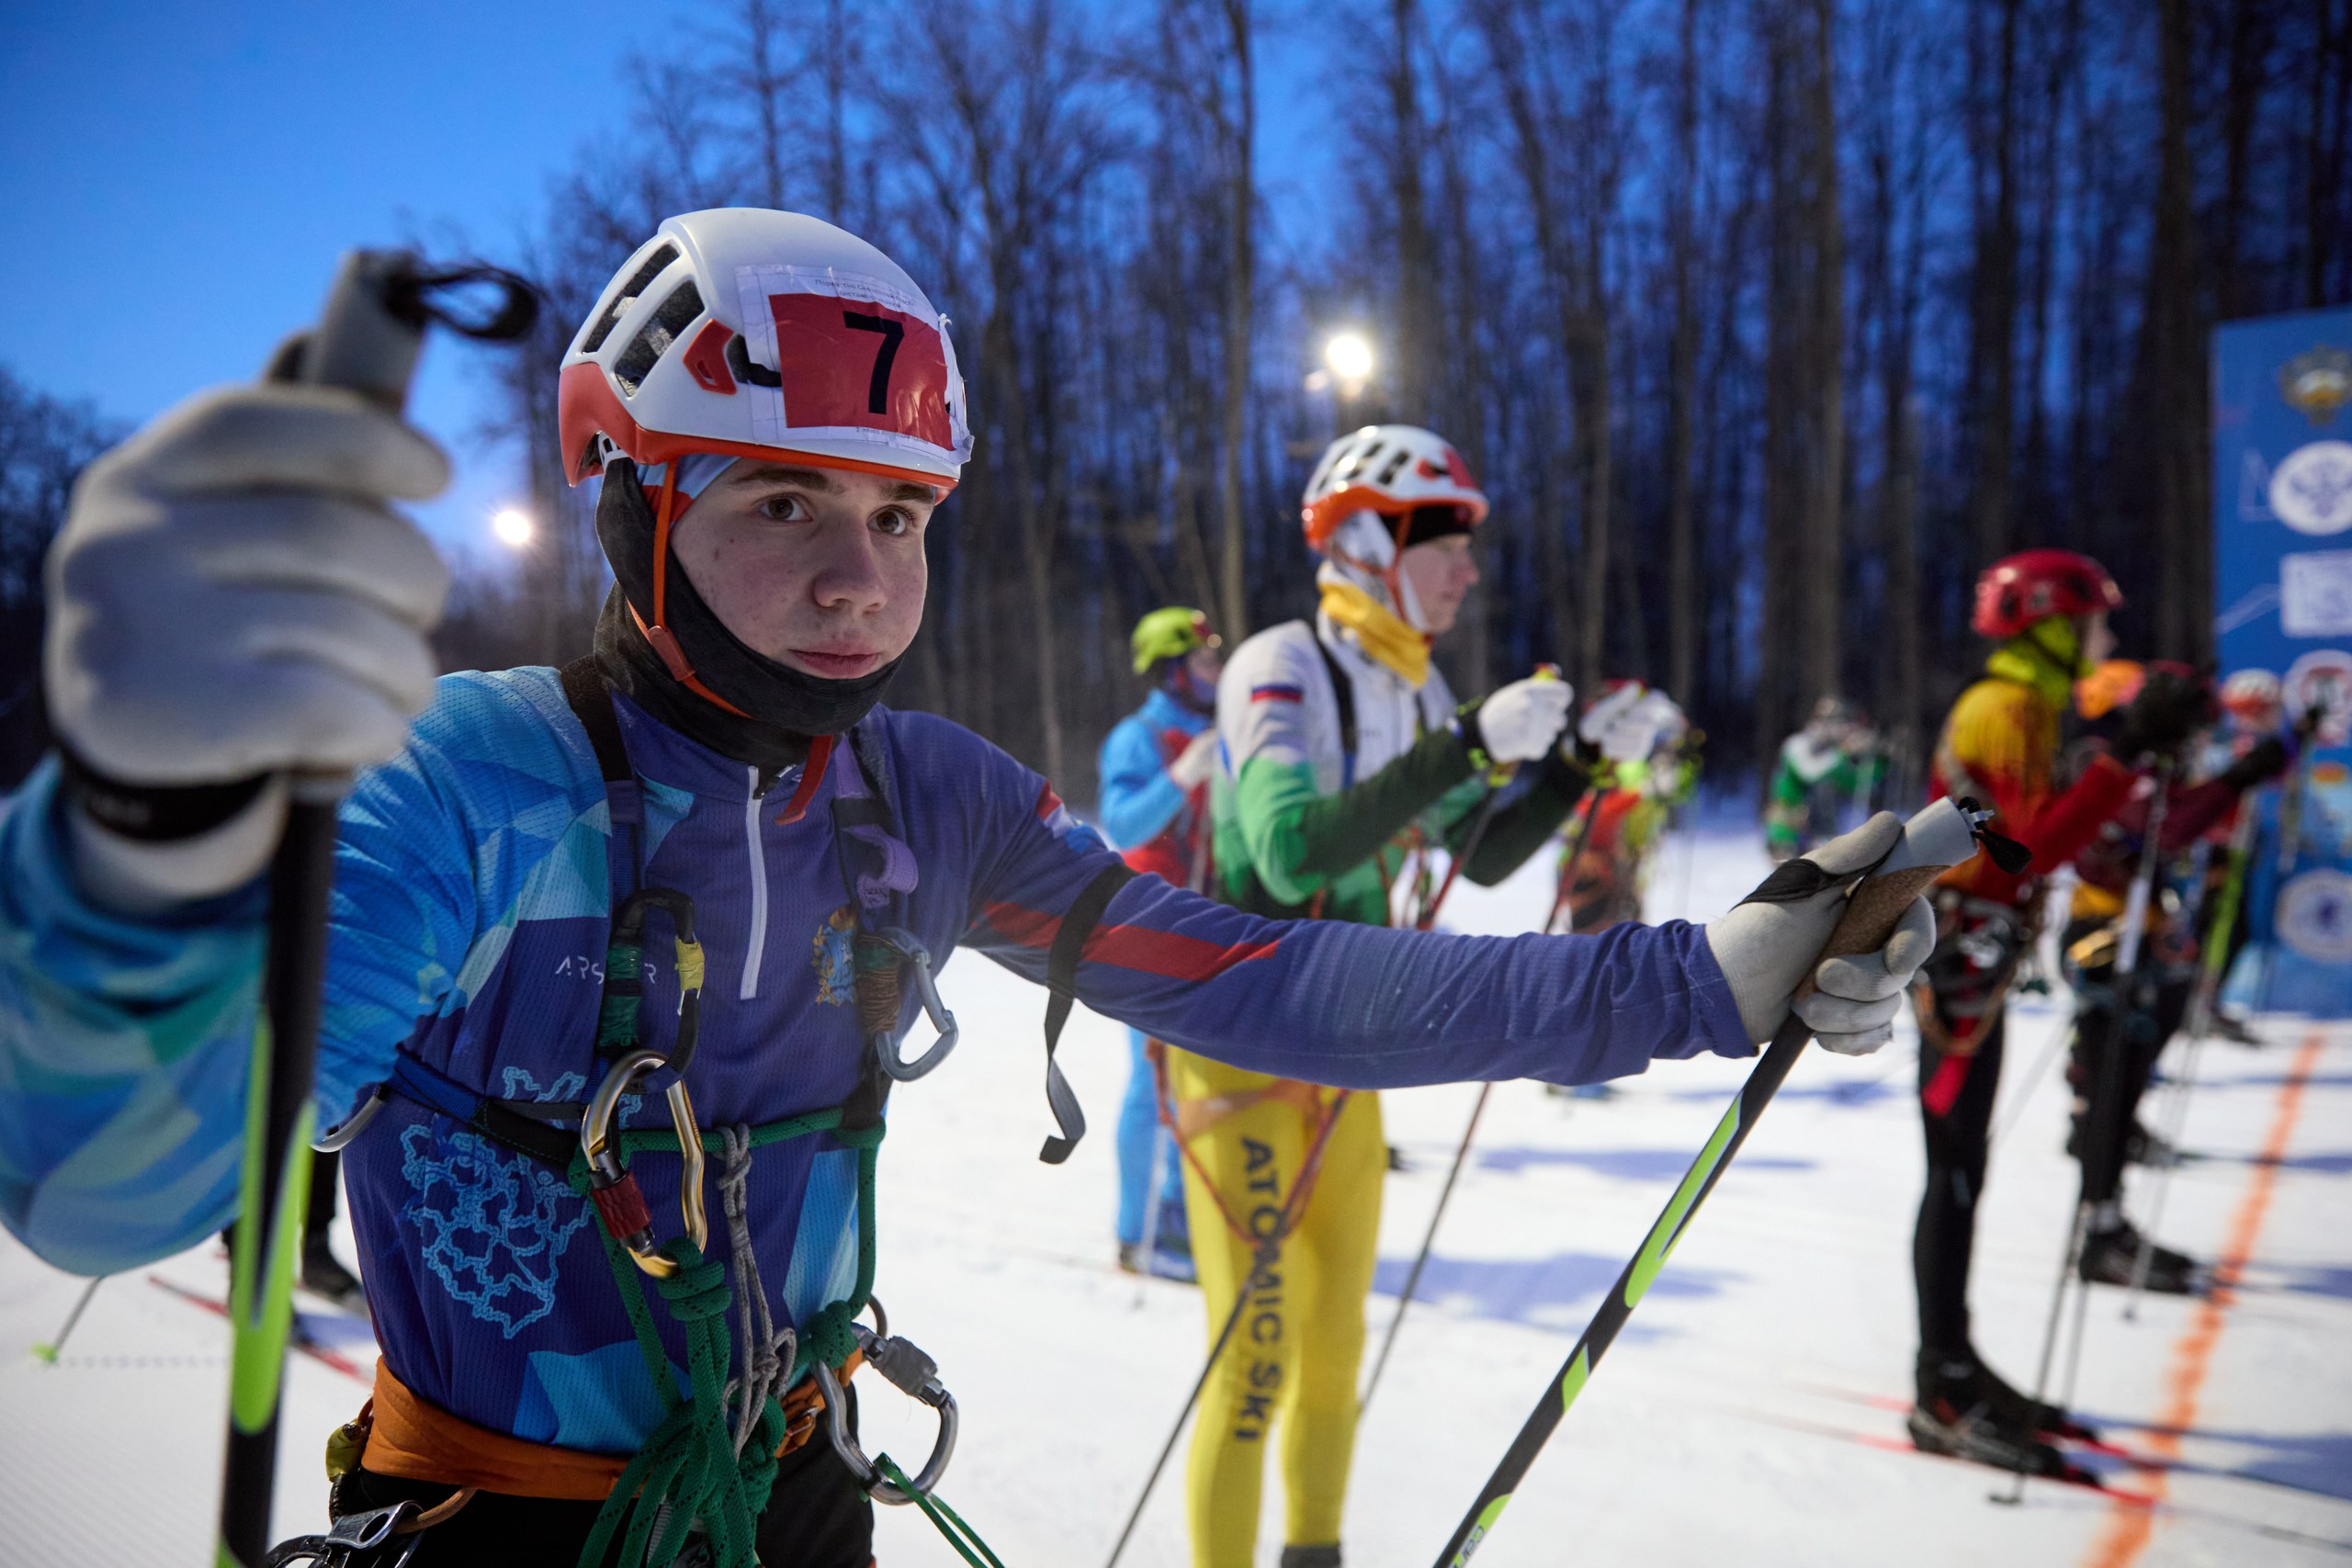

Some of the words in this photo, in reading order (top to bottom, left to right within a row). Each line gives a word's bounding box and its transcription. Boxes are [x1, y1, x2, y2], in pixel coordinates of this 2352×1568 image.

[842, 310, 904, 415] 7
[322, 1136, 364, 1344] ATOMIC
[316, 1361, 365, 1441] SKI
